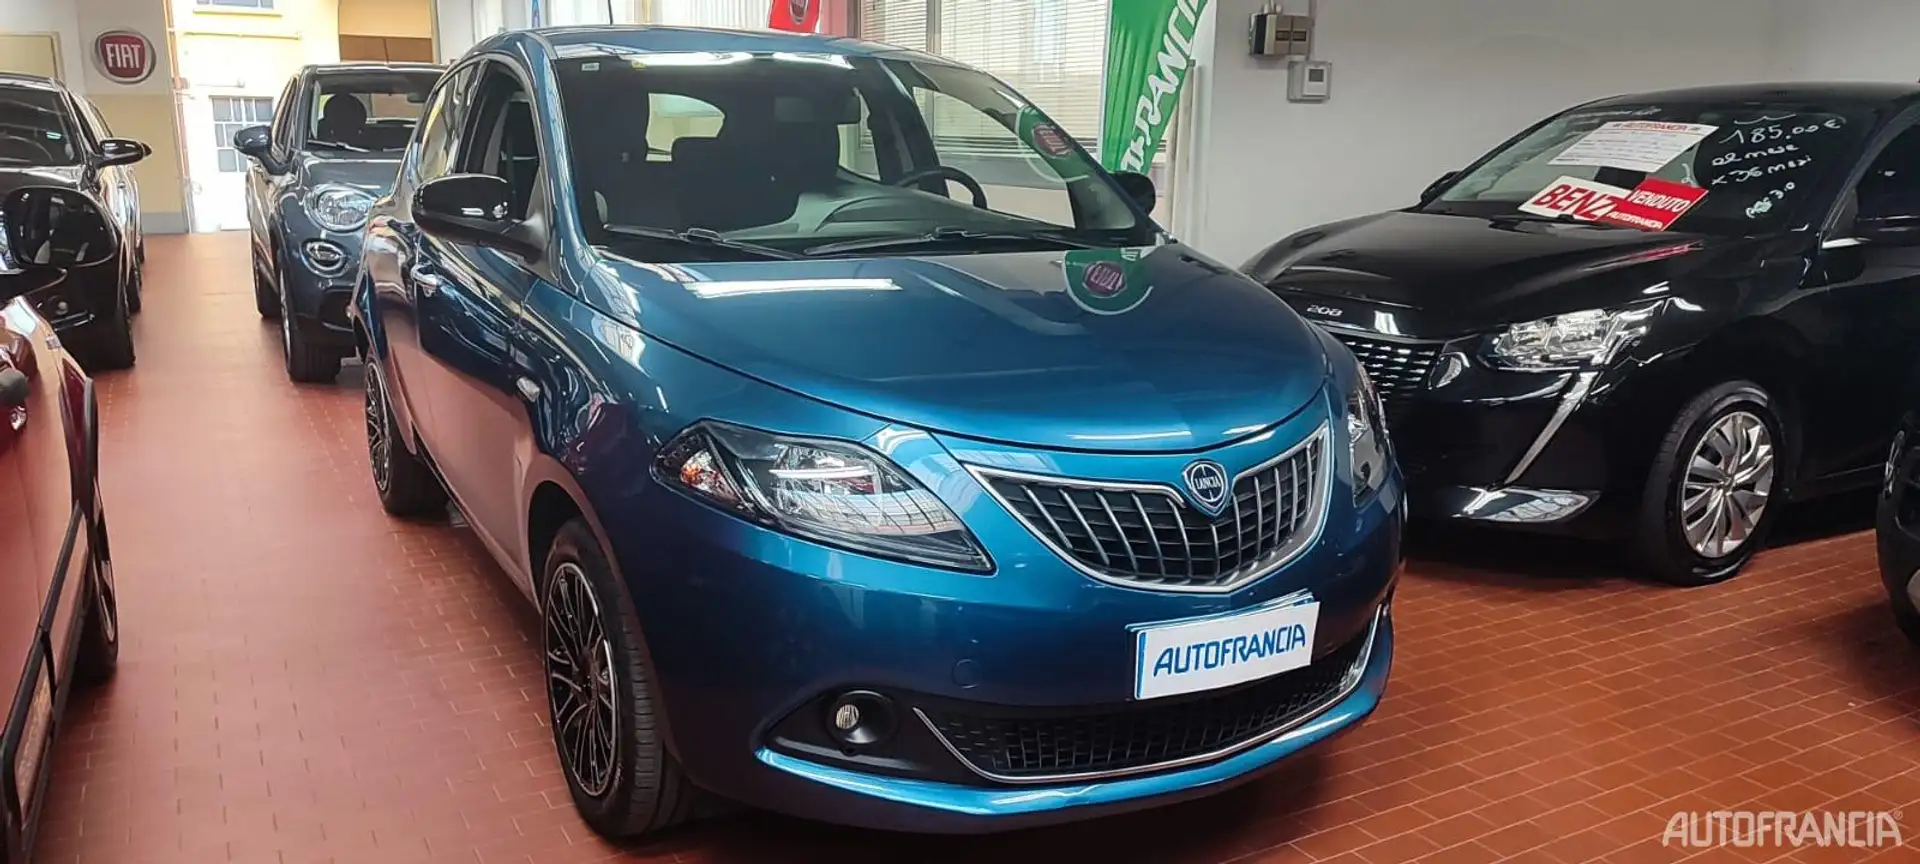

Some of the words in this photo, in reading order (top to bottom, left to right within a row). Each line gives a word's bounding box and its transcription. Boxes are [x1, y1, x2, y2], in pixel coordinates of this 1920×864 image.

[105, 43, 141, 69] FIAT
[1728, 166, 1763, 182] 36
[1532, 184, 1622, 221] BENZ
[1627, 189, 1691, 213] VENDUTO
[1307, 304, 1342, 316] 208
[1194, 475, 1221, 490] LANCIA
[1153, 623, 1306, 677] AUTOFRANCIA
